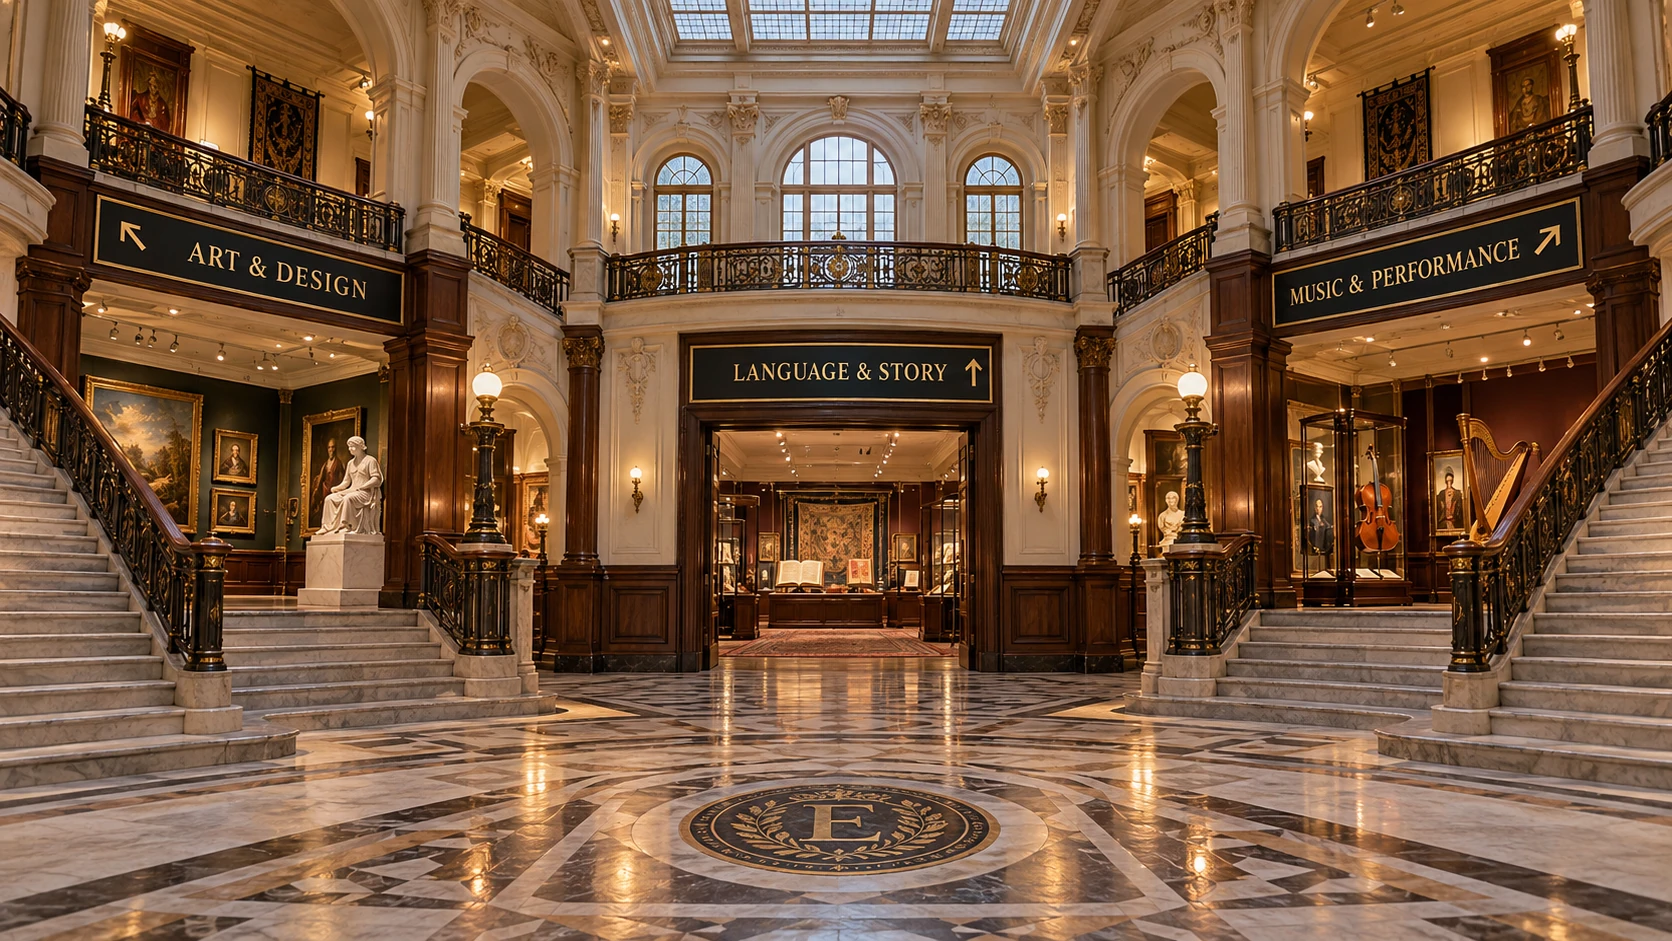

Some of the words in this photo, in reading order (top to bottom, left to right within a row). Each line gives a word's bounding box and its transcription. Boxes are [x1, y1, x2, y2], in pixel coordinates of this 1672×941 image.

[187, 241, 241, 272] ART
[248, 255, 267, 279] &
[276, 261, 367, 300] DESIGN
[1290, 277, 1344, 306] MUSIC
[1349, 274, 1364, 294] &
[1371, 237, 1520, 290] PERFORMANCE
[733, 362, 850, 382] LANGUAGE
[856, 362, 872, 381] &
[878, 362, 948, 382] STORY
[799, 804, 882, 842] E
